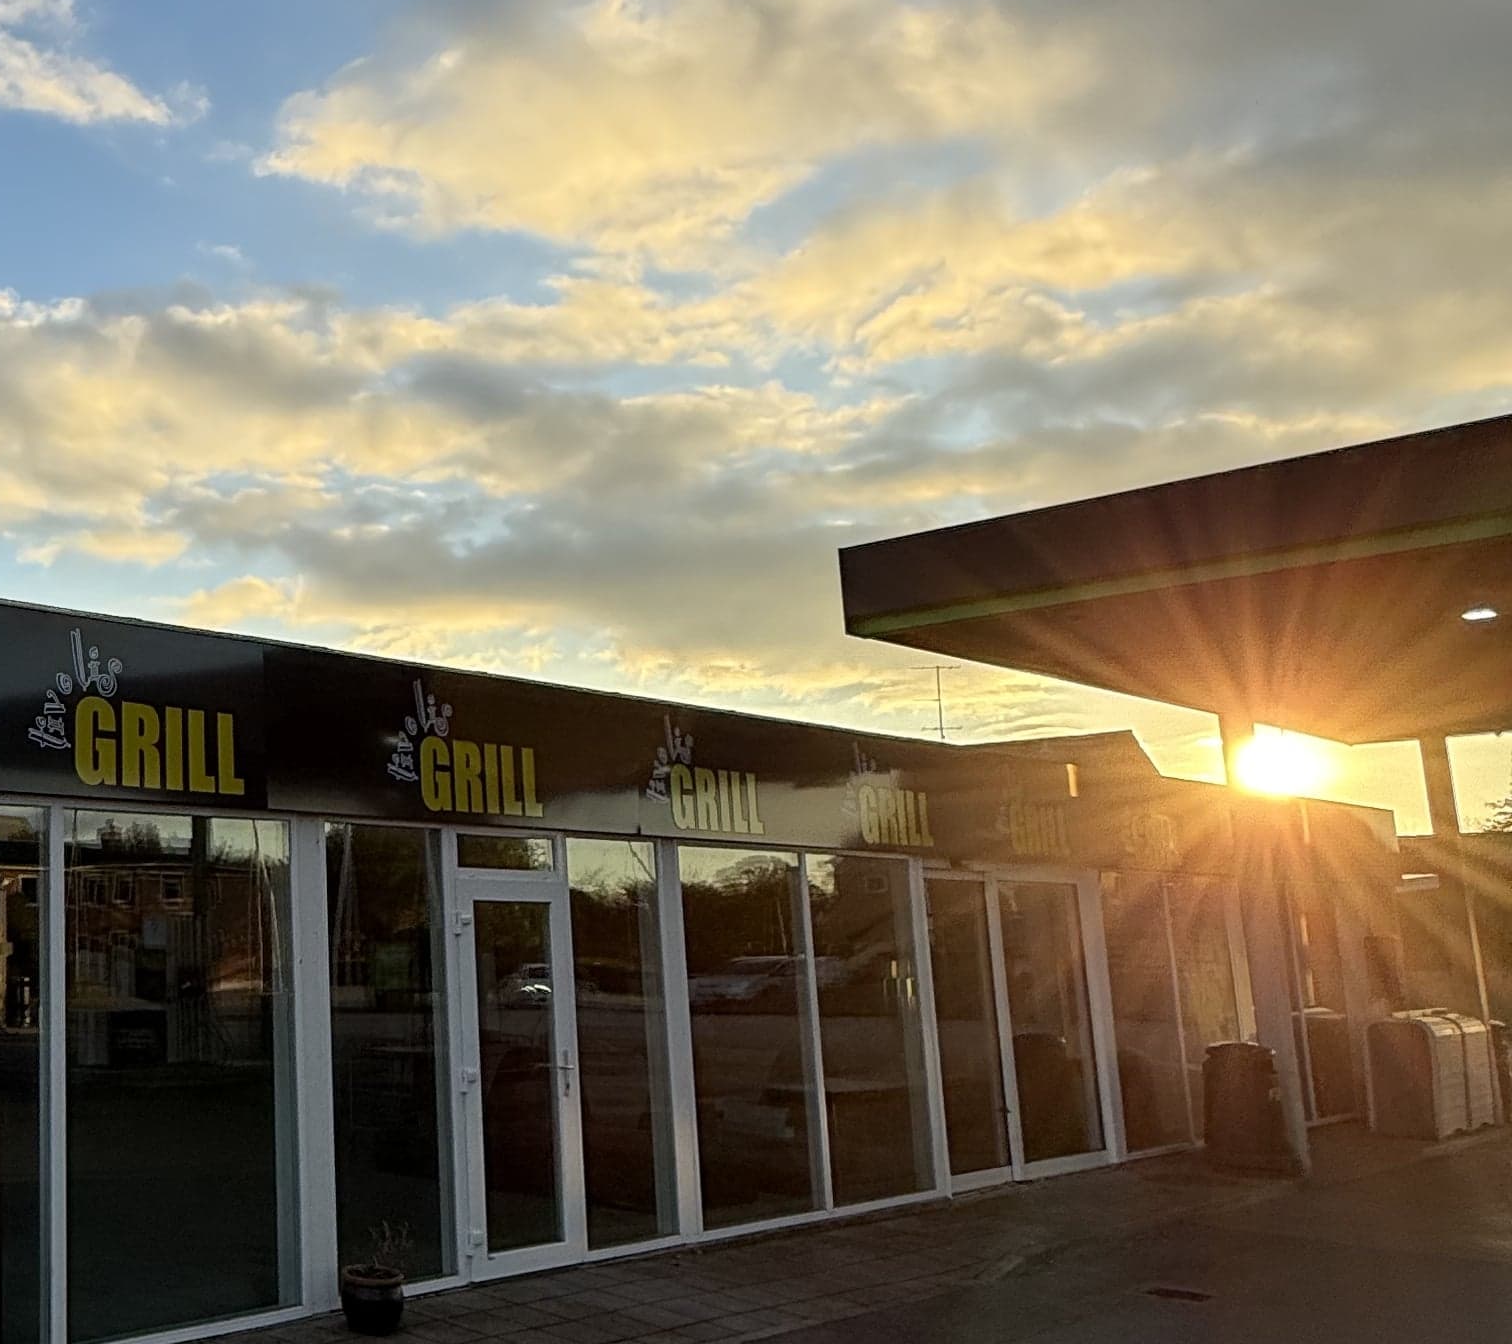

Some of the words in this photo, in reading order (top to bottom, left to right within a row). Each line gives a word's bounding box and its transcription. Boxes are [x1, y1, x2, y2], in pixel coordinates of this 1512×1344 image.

[74, 695, 245, 795] GRILL
[419, 736, 544, 818] GRILL
[670, 763, 765, 835] GRILL
[858, 784, 934, 847] GRILL
